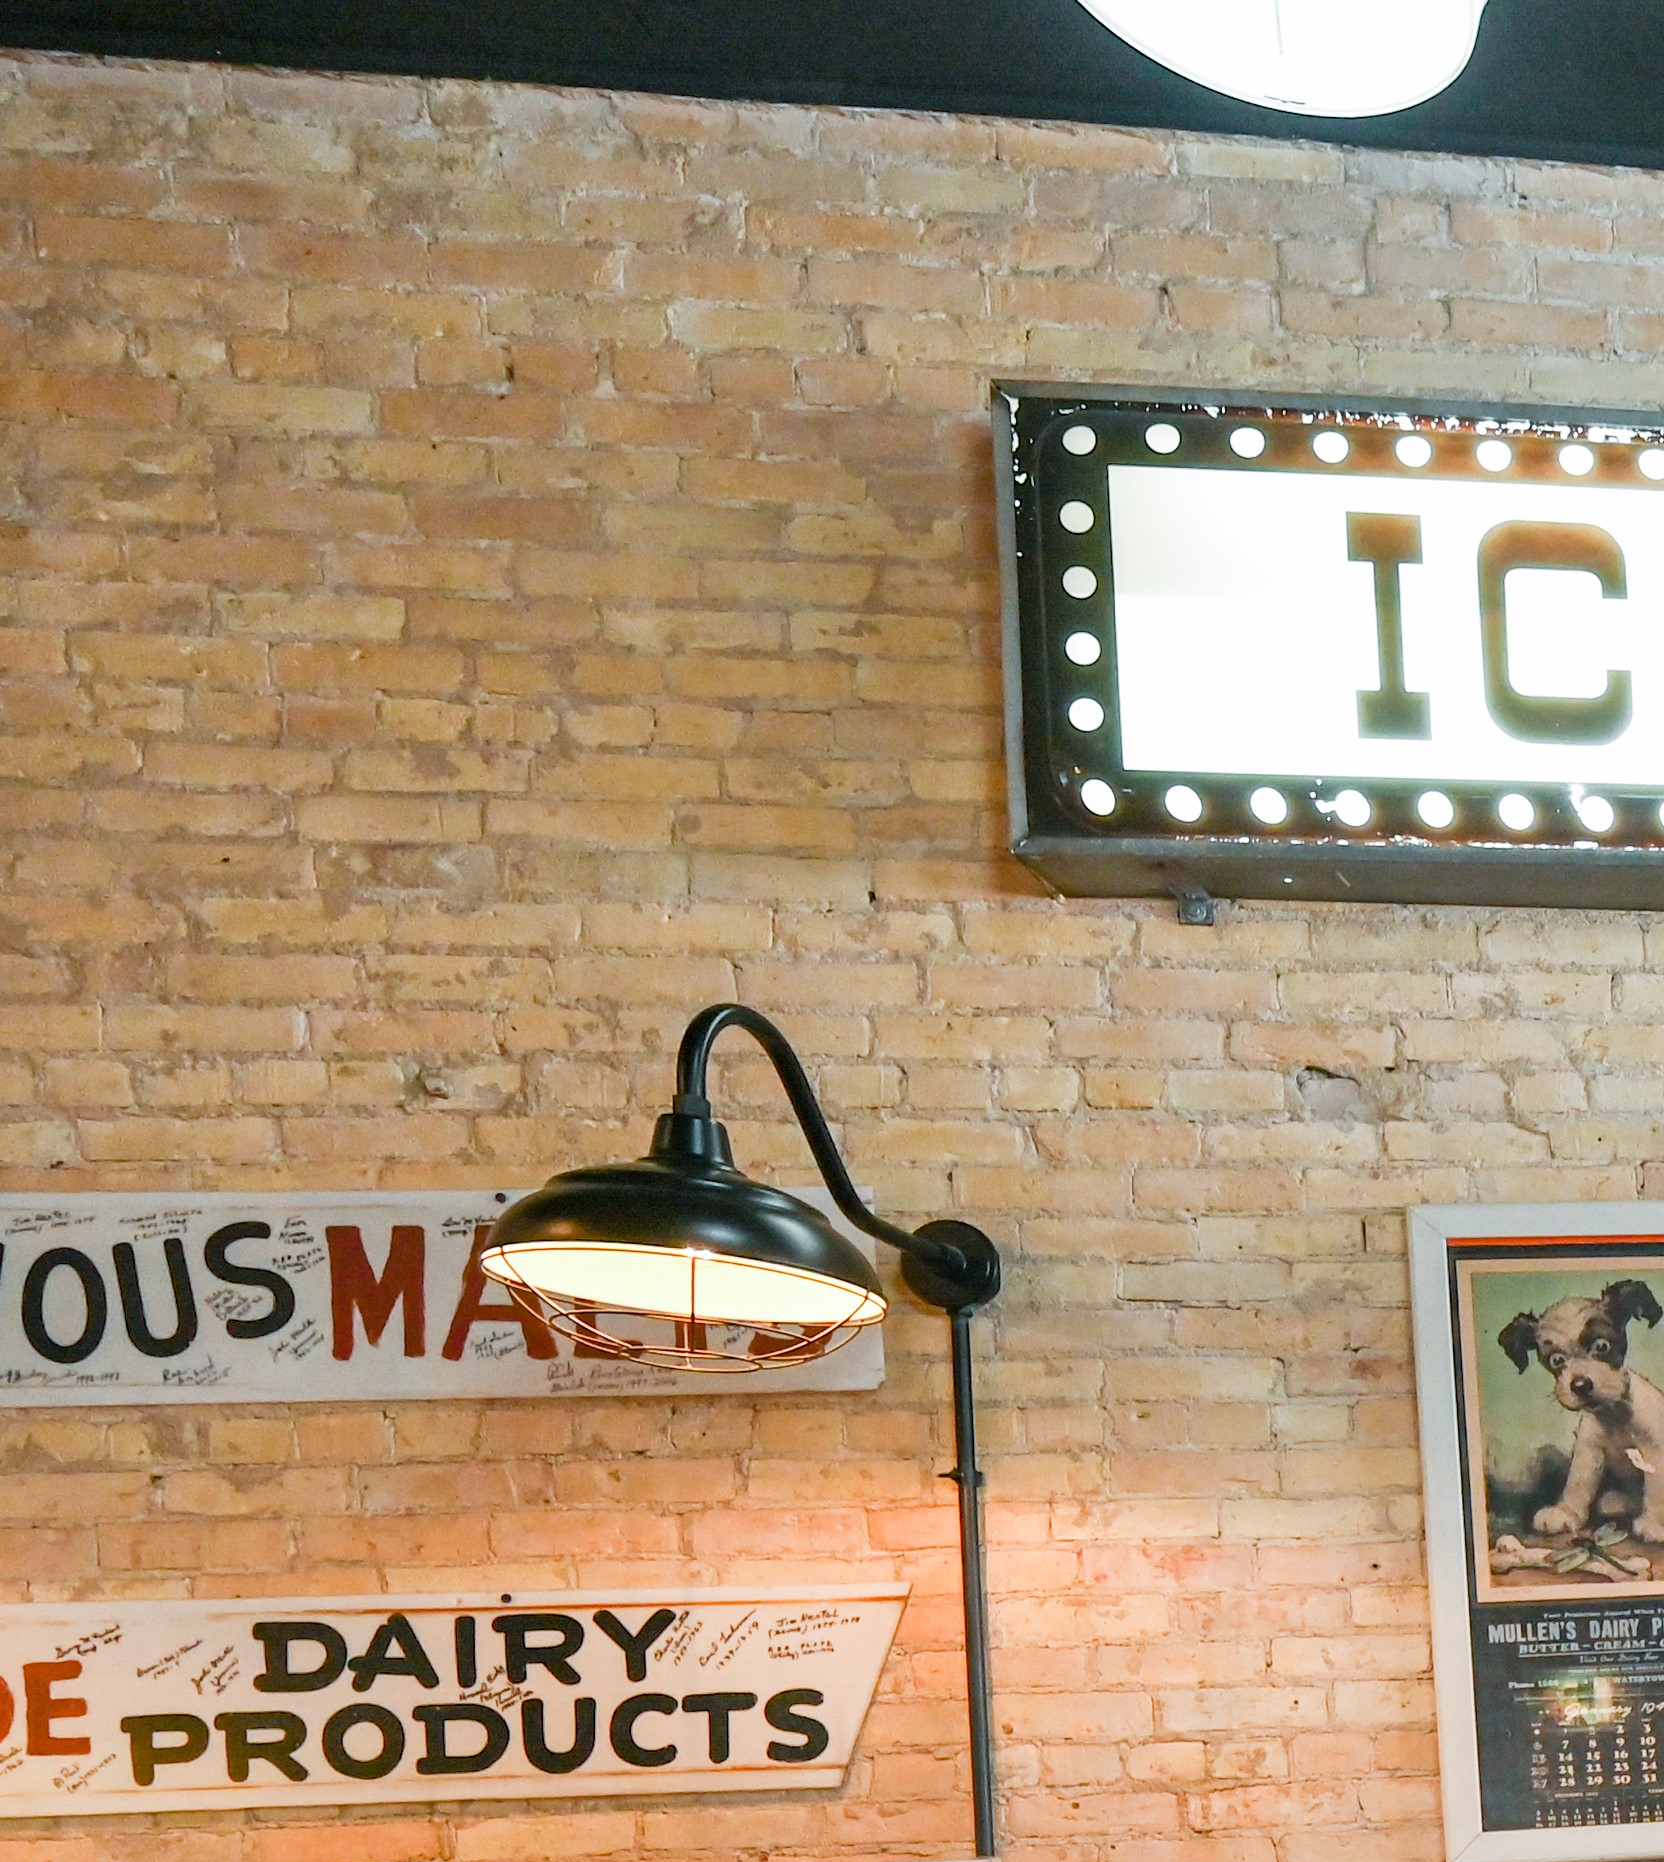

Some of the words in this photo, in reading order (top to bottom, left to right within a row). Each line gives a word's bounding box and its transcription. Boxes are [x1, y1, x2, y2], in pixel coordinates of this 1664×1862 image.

[1488, 1621, 1577, 1643] MULLEN'S
[1590, 1618, 1639, 1639] DAIRY
[253, 1609, 676, 1694] DAIRY
[1519, 1642, 1579, 1654] BUTTER
[1594, 1639, 1645, 1649] CREAM
[120, 1688, 829, 1788] PRODUCTS
[1562, 1740, 1569, 1749] 7
[1640, 1737, 1656, 1745] 10
[1614, 1751, 1628, 1759] 16
[1642, 1750, 1655, 1758] 17
[1613, 1776, 1631, 1785] 30
[1642, 1773, 1656, 1783] 31
